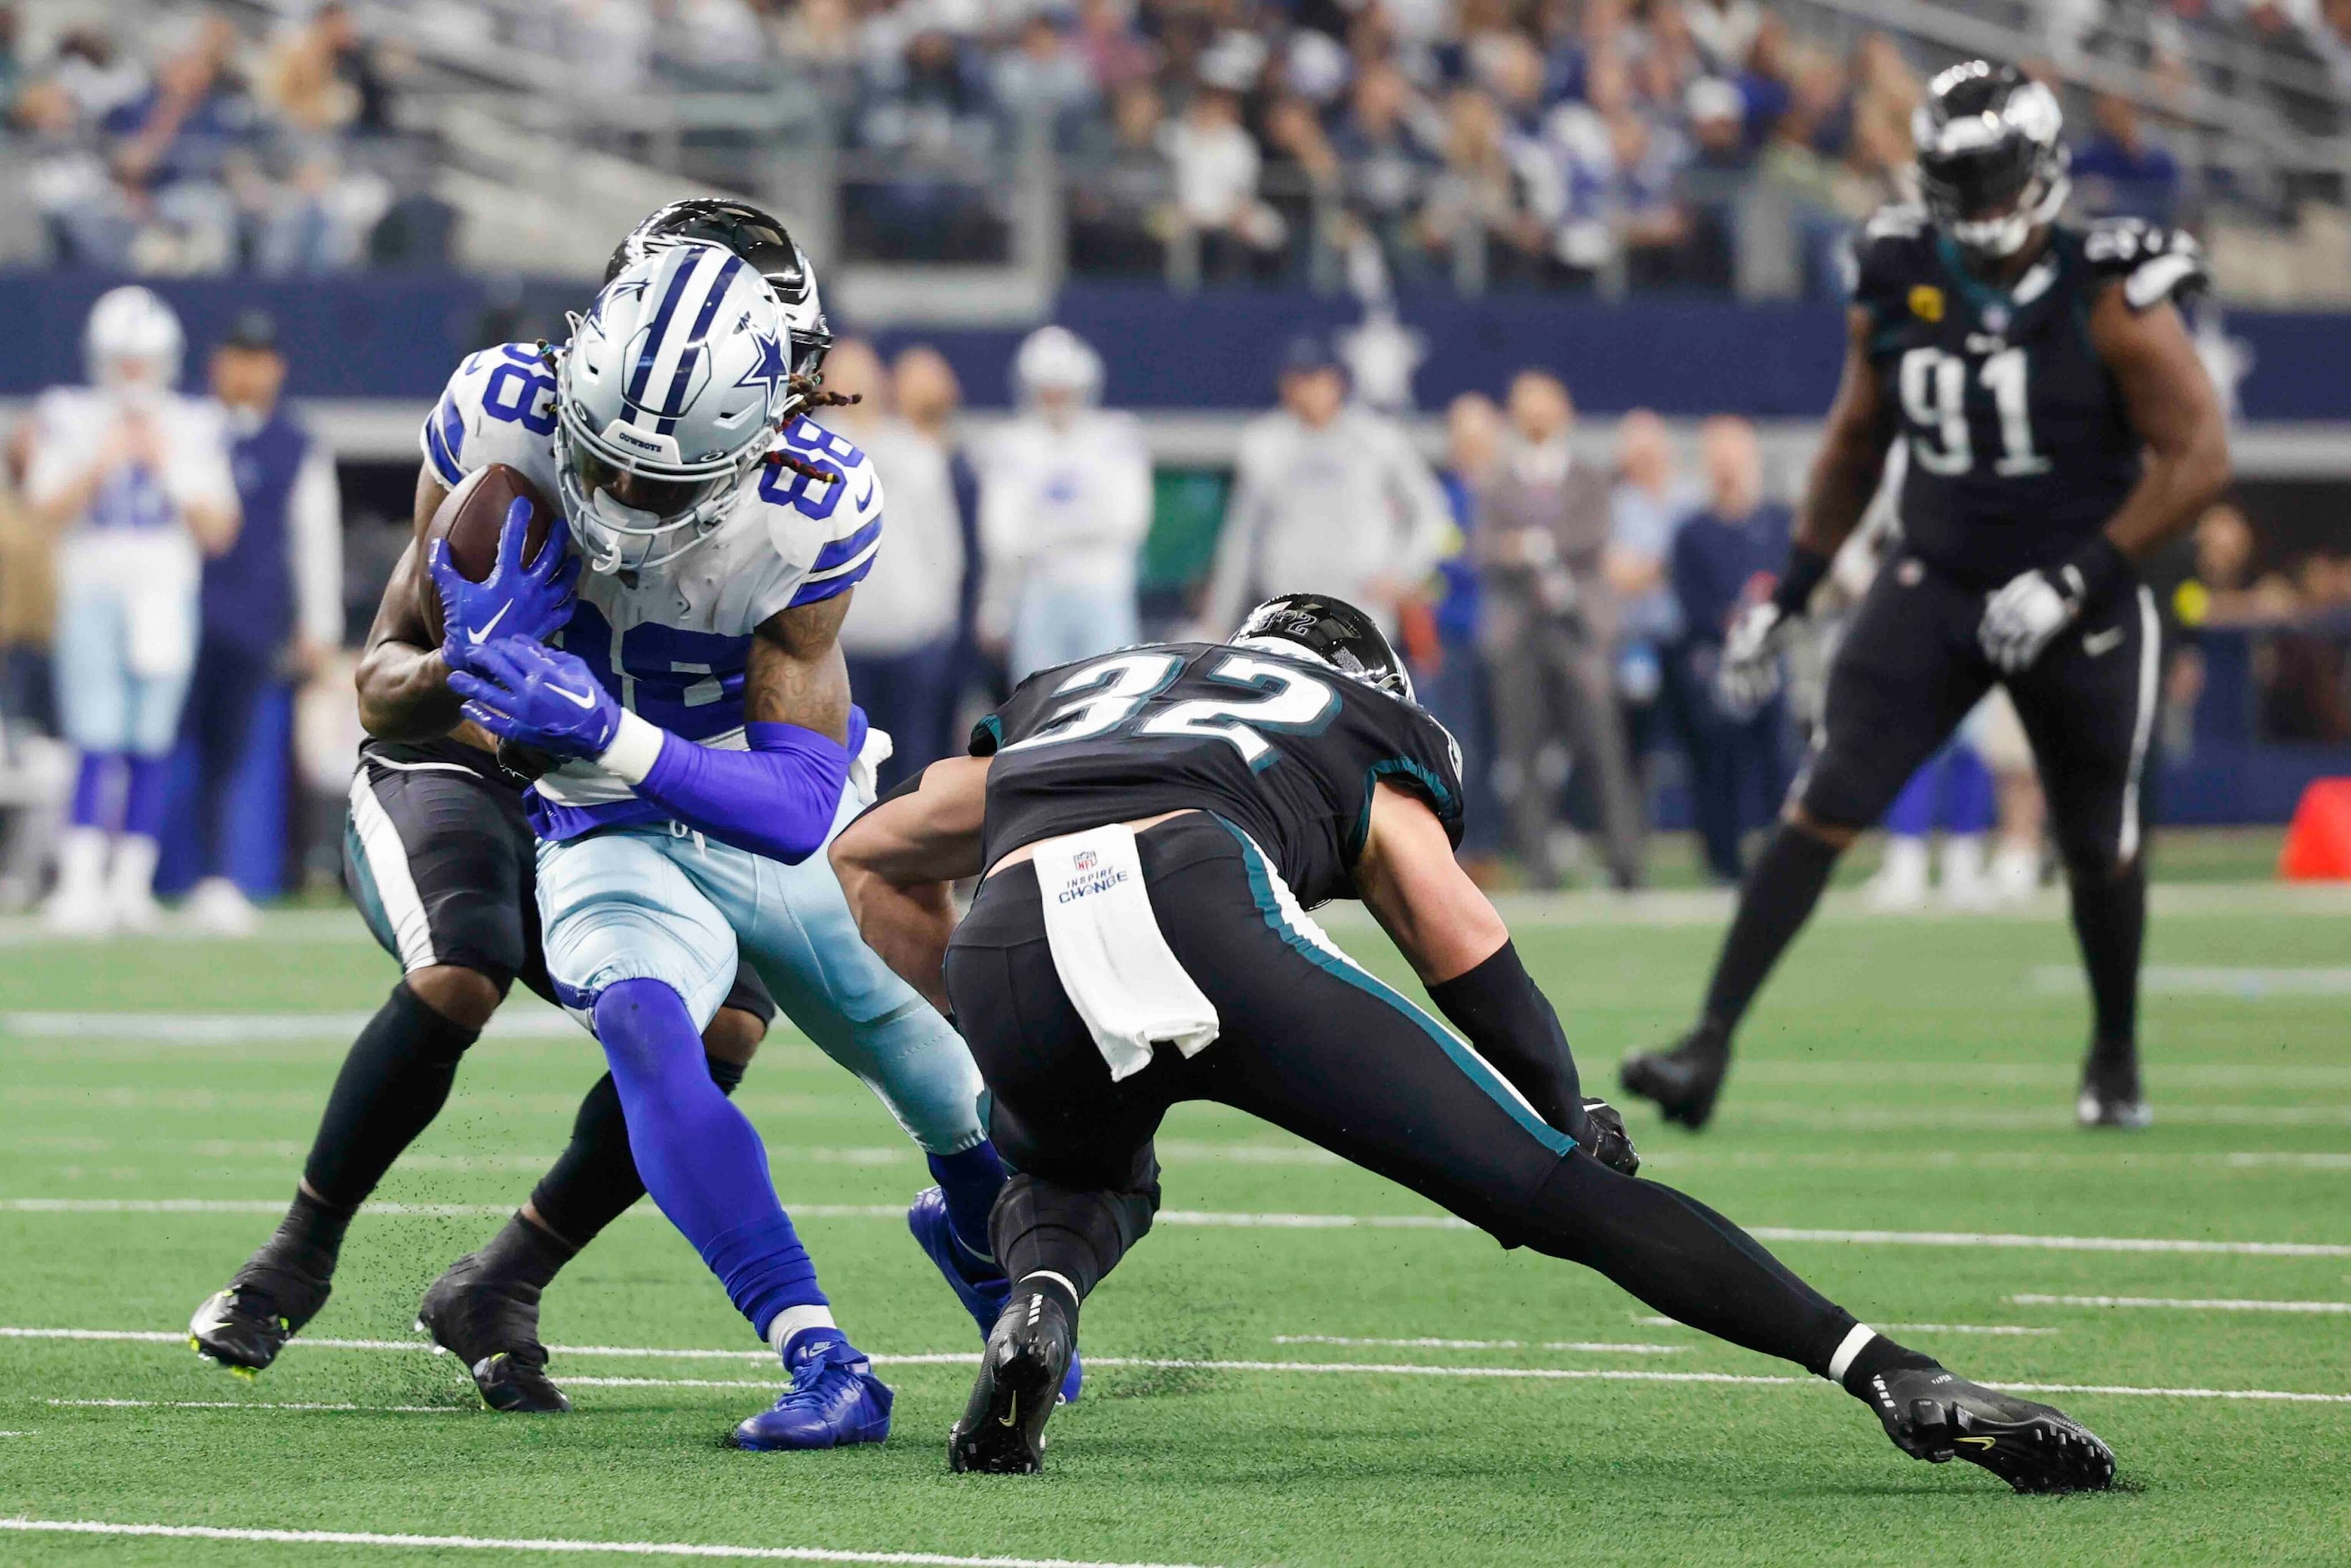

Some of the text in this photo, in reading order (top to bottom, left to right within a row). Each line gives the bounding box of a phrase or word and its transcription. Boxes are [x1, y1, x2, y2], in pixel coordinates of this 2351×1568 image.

[619, 432, 662, 452] COWBOYS
[1899, 346, 2054, 476] 91
[758, 413, 865, 521] 88
[999, 654, 1342, 776] 32
[1059, 871, 1128, 903] CHANGE
[1078, 858, 1096, 871] NFL
